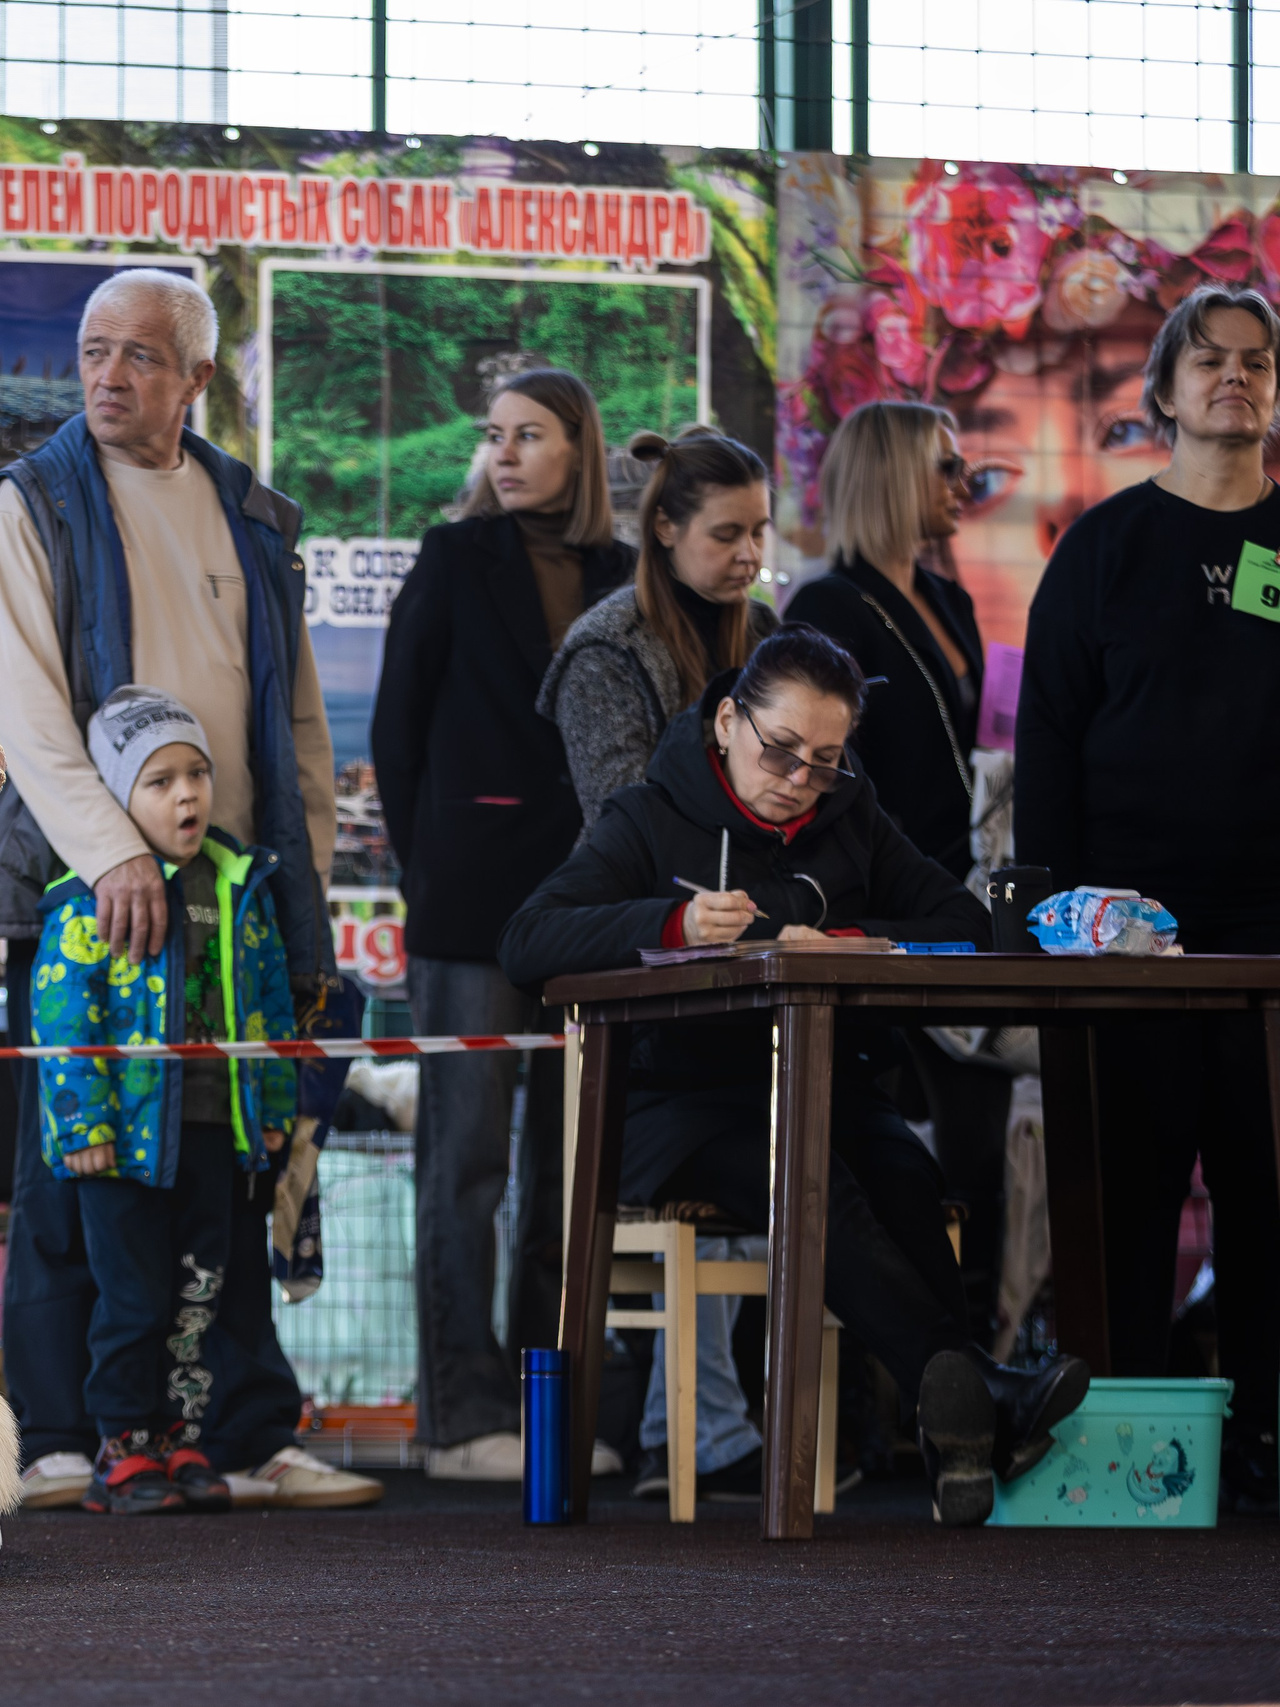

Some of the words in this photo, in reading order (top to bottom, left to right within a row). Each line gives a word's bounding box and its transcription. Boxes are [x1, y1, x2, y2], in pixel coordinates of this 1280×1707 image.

[93, 169, 333, 252] ПОРОДИСТЫХ
[340, 178, 452, 249] СОБАК
[113, 709, 195, 755] LEGEND
